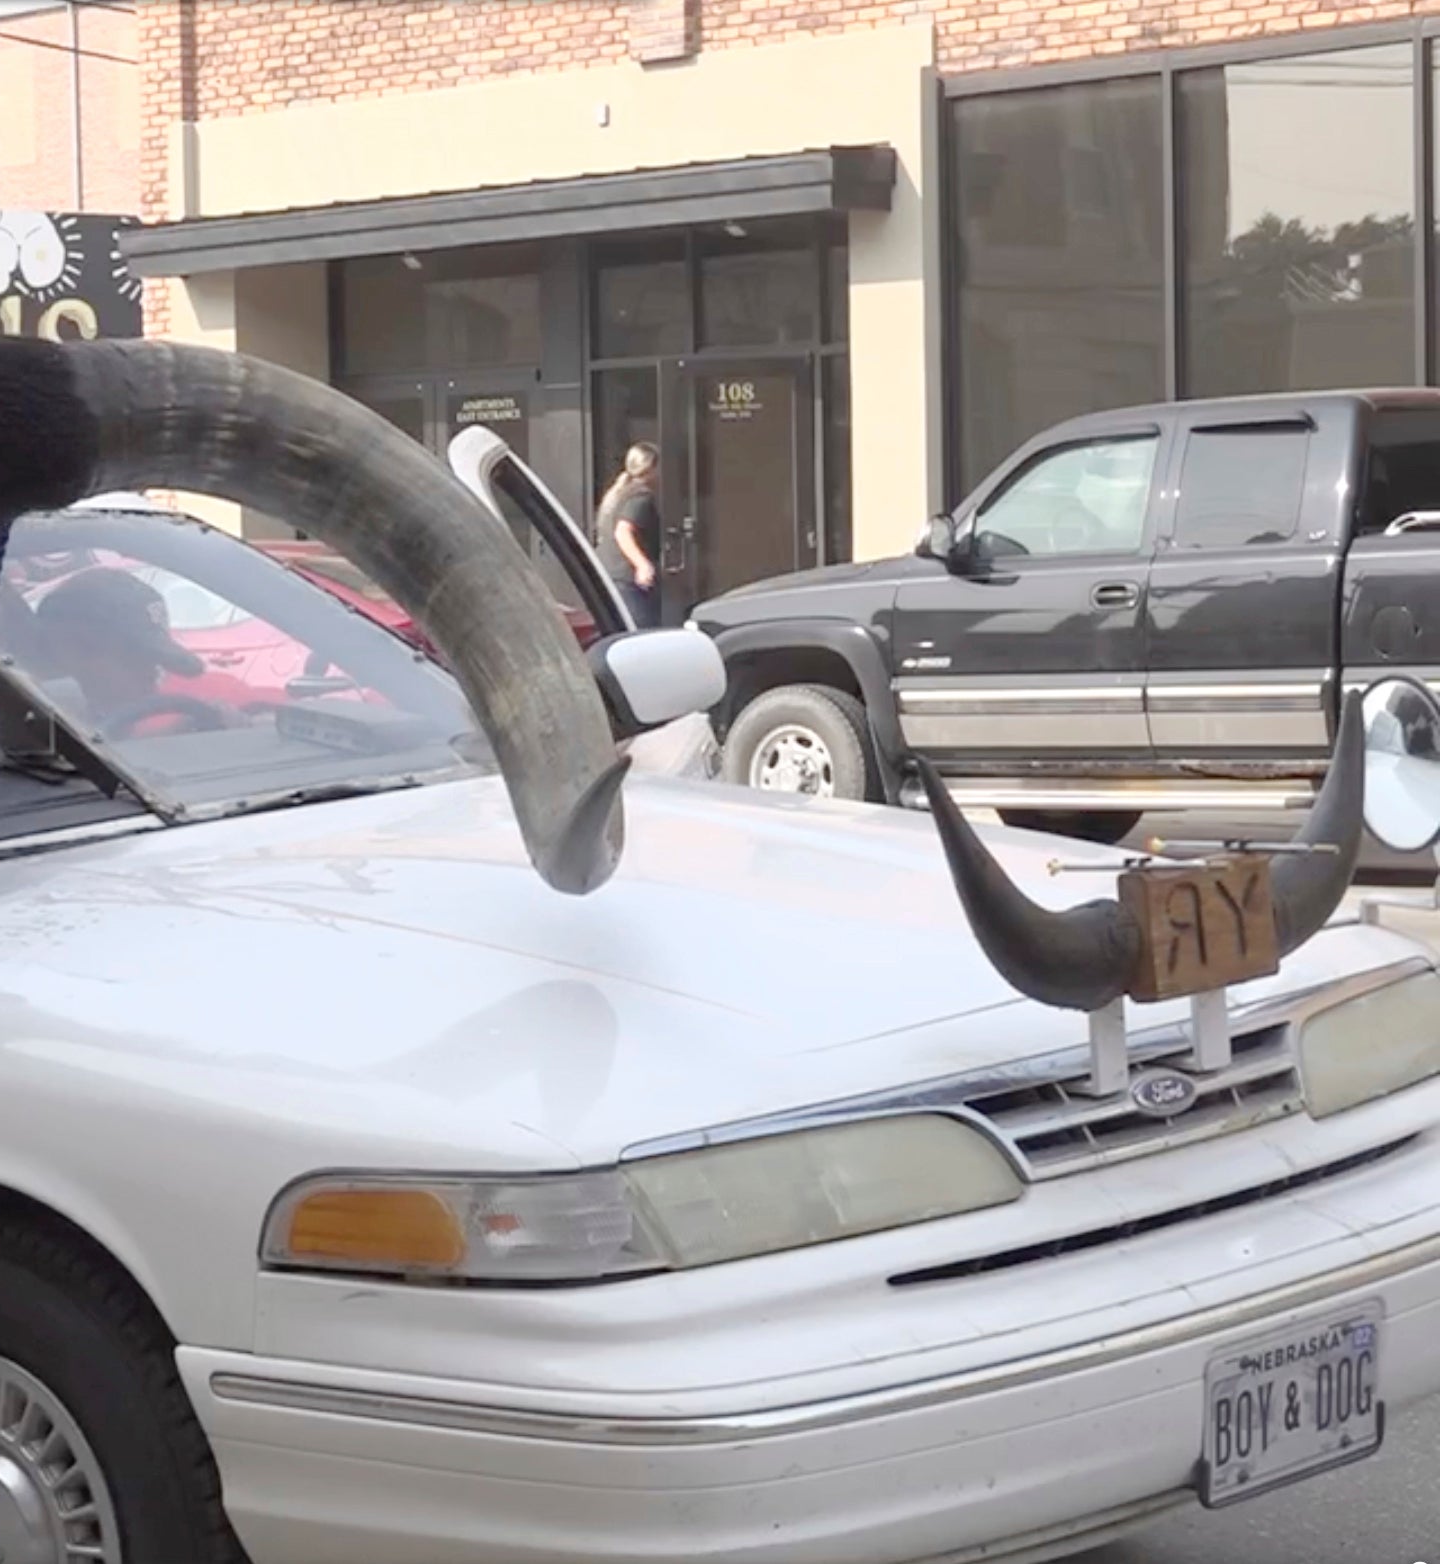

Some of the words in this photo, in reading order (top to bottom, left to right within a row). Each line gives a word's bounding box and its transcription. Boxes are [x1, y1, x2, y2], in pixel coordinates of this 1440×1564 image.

[719, 382, 755, 402] 108
[1151, 1080, 1186, 1103] Ford
[1249, 1330, 1342, 1375] NEBRASKA
[1215, 1380, 1274, 1467] BOY
[1284, 1380, 1301, 1431] &
[1316, 1350, 1373, 1432] DOG
